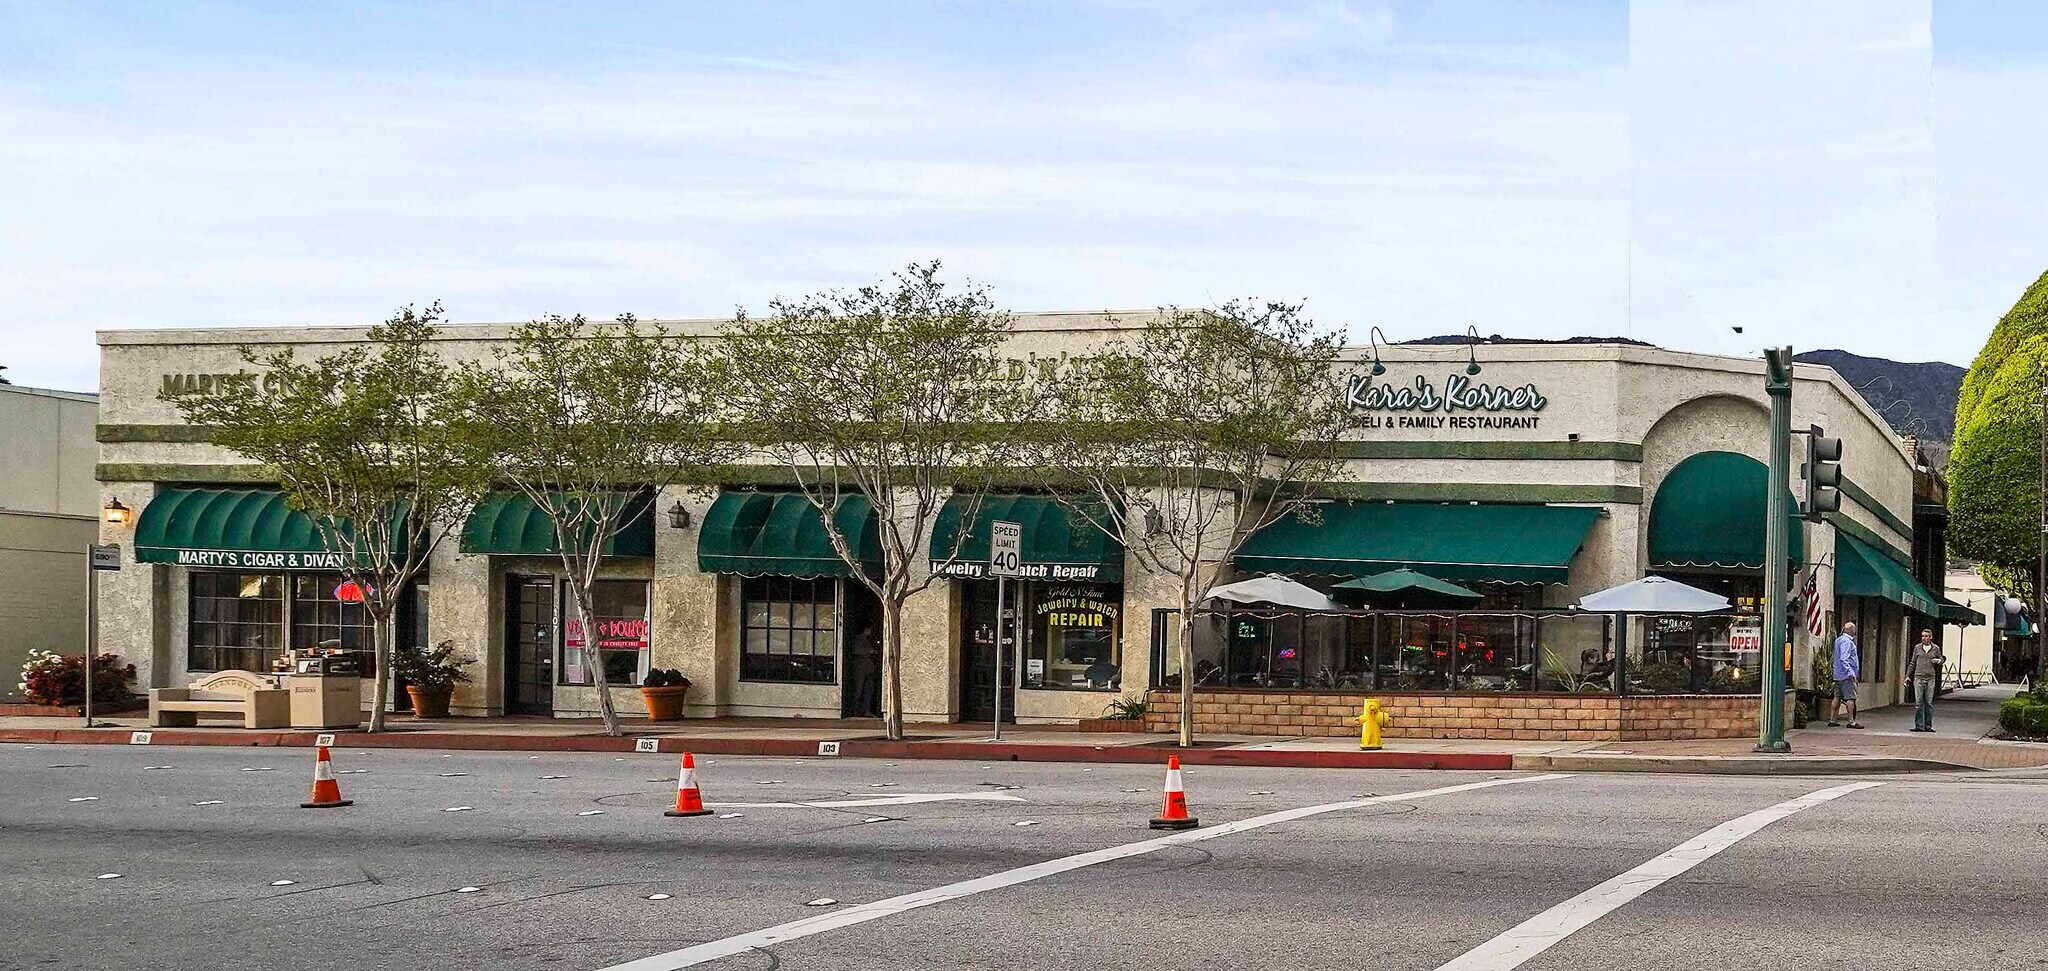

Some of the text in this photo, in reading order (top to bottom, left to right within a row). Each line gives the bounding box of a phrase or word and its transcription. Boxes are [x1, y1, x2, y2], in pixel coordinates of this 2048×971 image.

[1346, 375, 1546, 411] Kara's Korner
[1360, 416, 1540, 428] ELI & FAMILY RESTAURANT
[994, 526, 1019, 537] SPEED
[996, 539, 1016, 548] LIMIT
[178, 551, 237, 565] MARTY'S
[243, 553, 284, 567] CIGAR
[288, 554, 298, 566] &
[993, 551, 1018, 571] 40
[1019, 564, 1048, 577] atch
[1053, 565, 1098, 579] Repair
[1037, 598, 1077, 615] Jewelry
[1080, 598, 1086, 608] &
[1049, 613, 1103, 627] REPAIR
[1731, 637, 1759, 650] OPEN
[320, 736, 331, 744] 107
[641, 741, 653, 750] 105
[823, 744, 836, 753] 103
